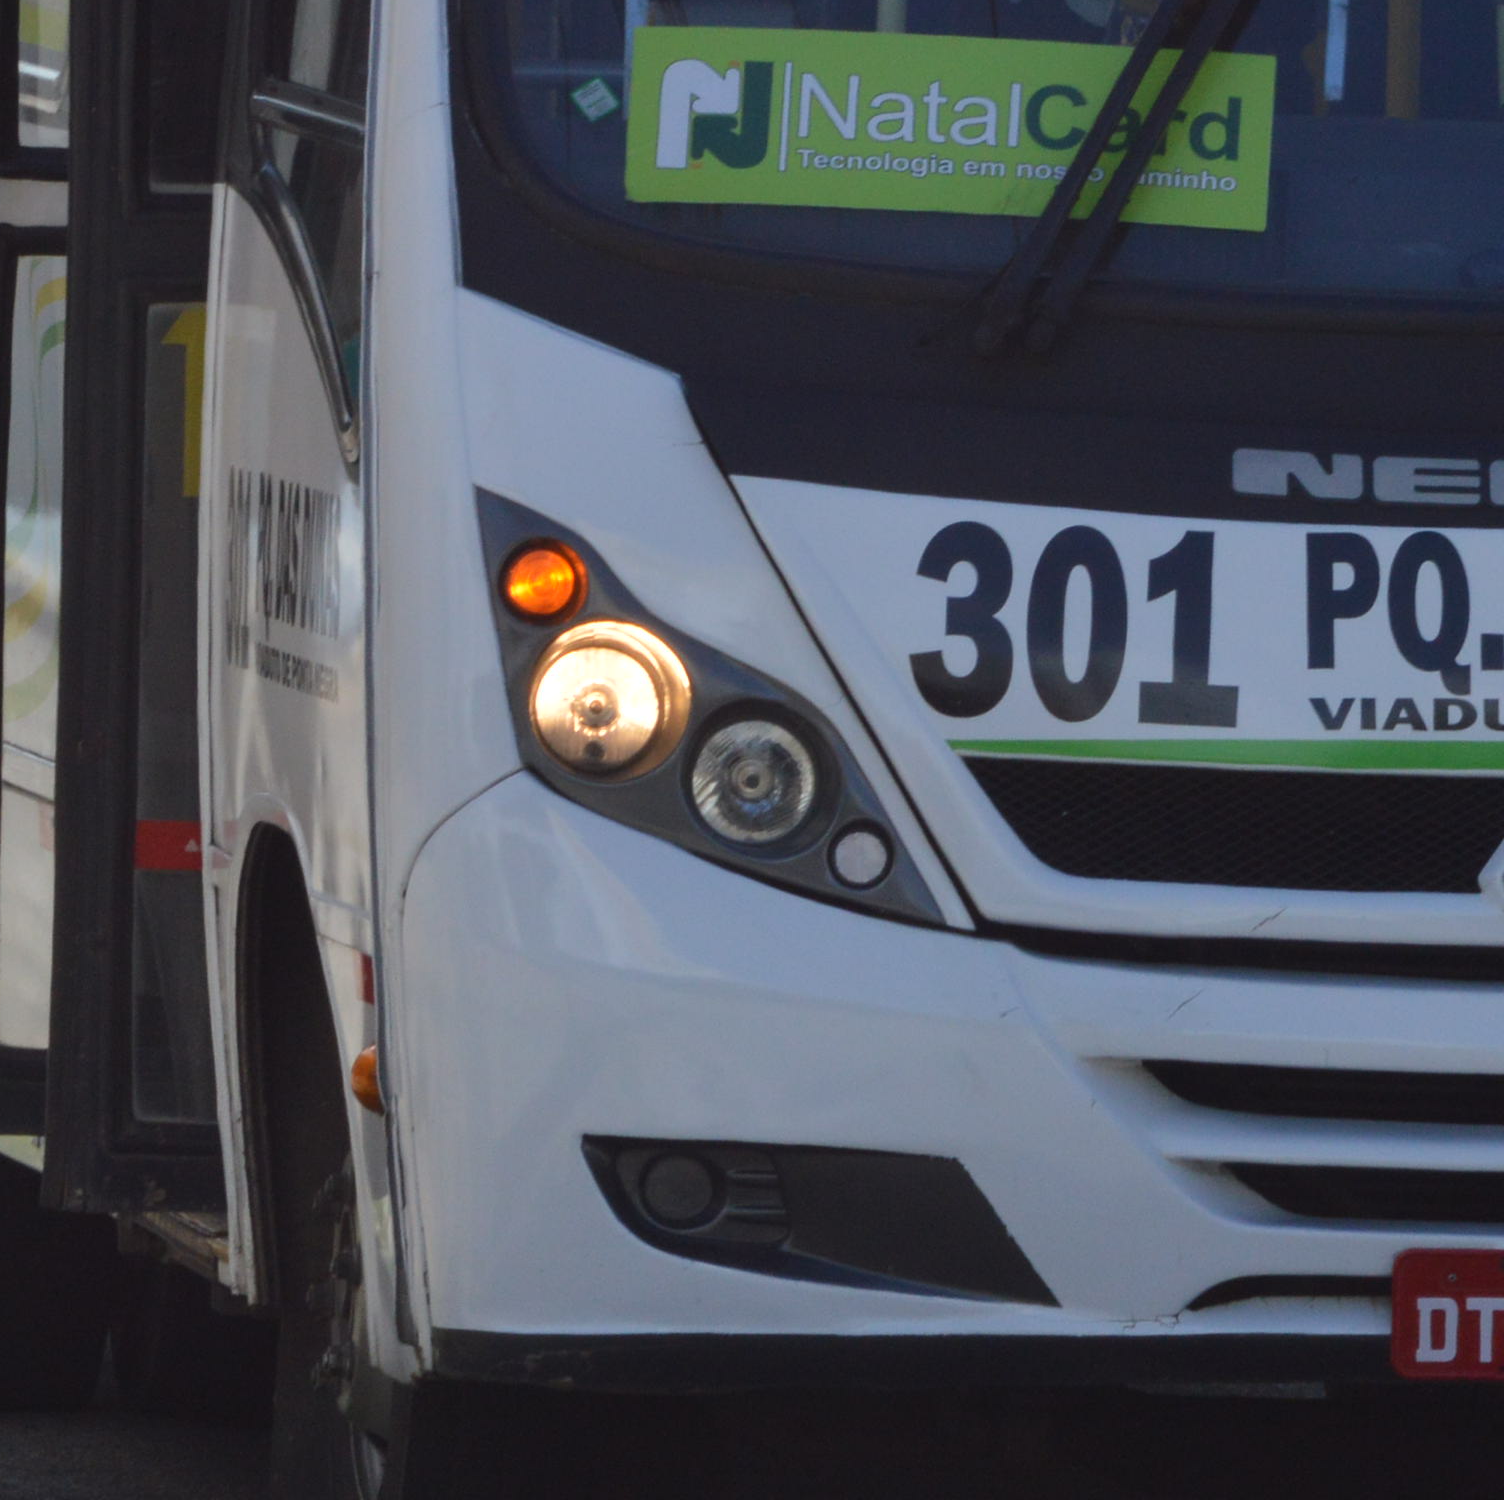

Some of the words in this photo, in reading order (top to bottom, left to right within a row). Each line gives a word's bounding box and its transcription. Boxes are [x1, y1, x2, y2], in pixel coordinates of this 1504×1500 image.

[797, 73, 1242, 160] NatalCard
[797, 149, 953, 177] Tecnologia
[963, 160, 1005, 177] em
[1017, 163, 1104, 182] noso
[1139, 169, 1237, 191] minho
[908, 520, 1239, 728] 301
[1307, 531, 1504, 695] PQ.
